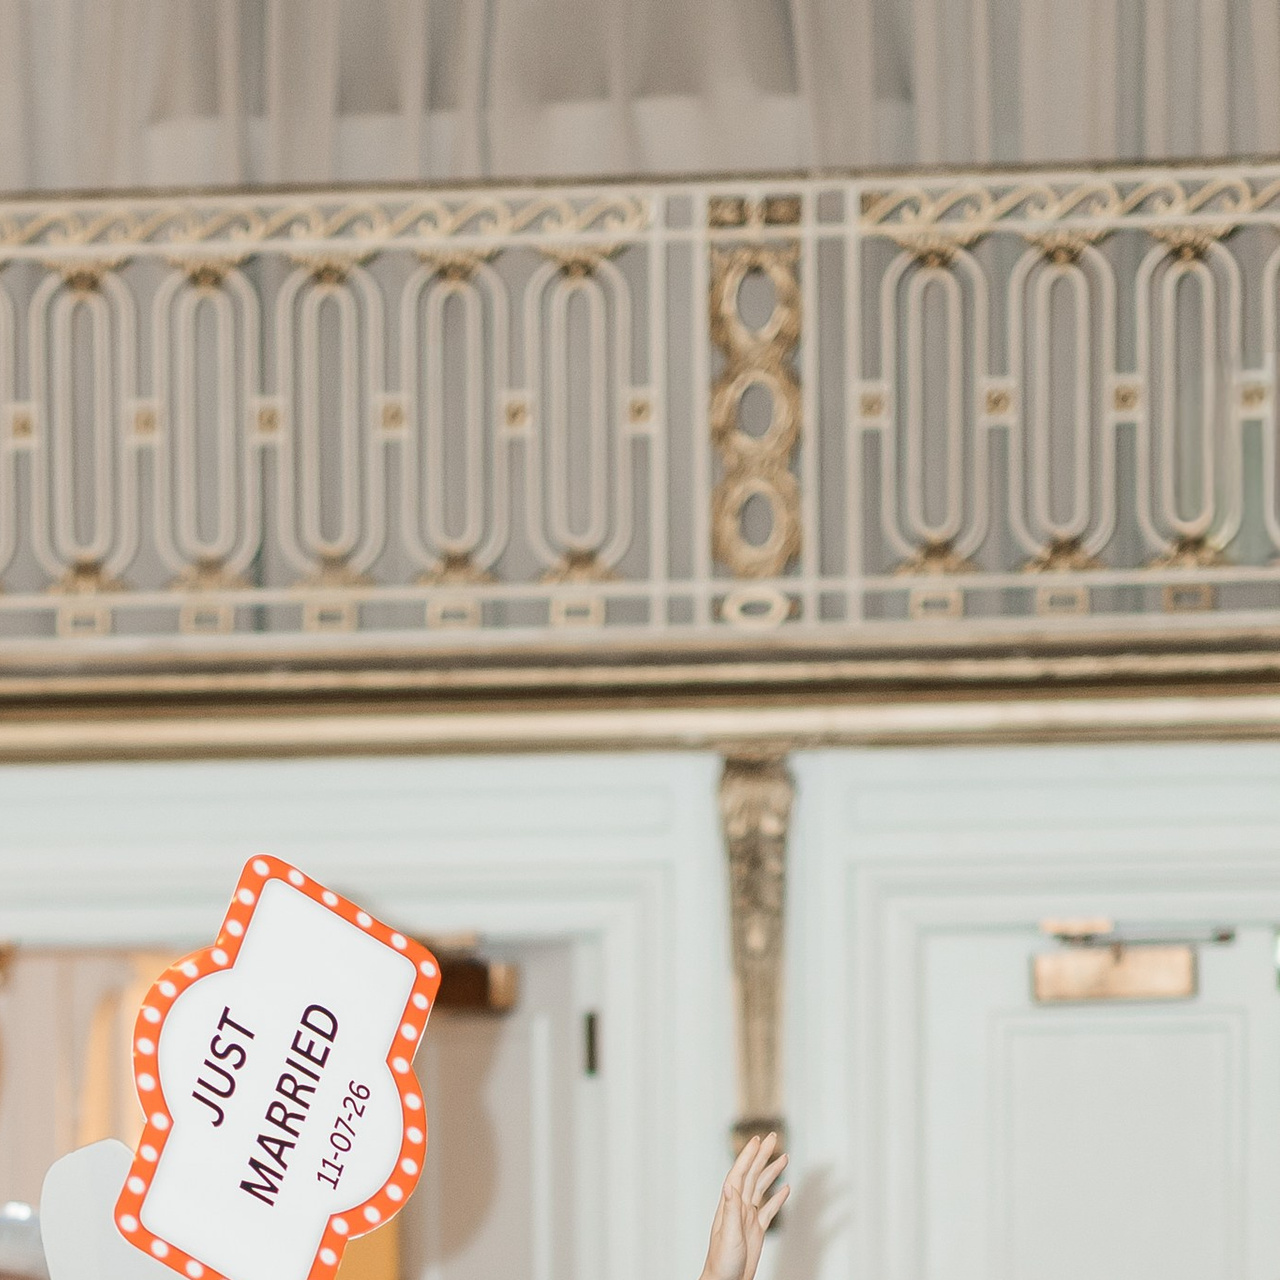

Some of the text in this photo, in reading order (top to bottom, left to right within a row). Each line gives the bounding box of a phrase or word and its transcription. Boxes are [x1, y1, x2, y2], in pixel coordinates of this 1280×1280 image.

[191, 1006, 257, 1128] JUST
[239, 1003, 340, 1207] MARRIED
[316, 1080, 371, 1190] 11-07-26
